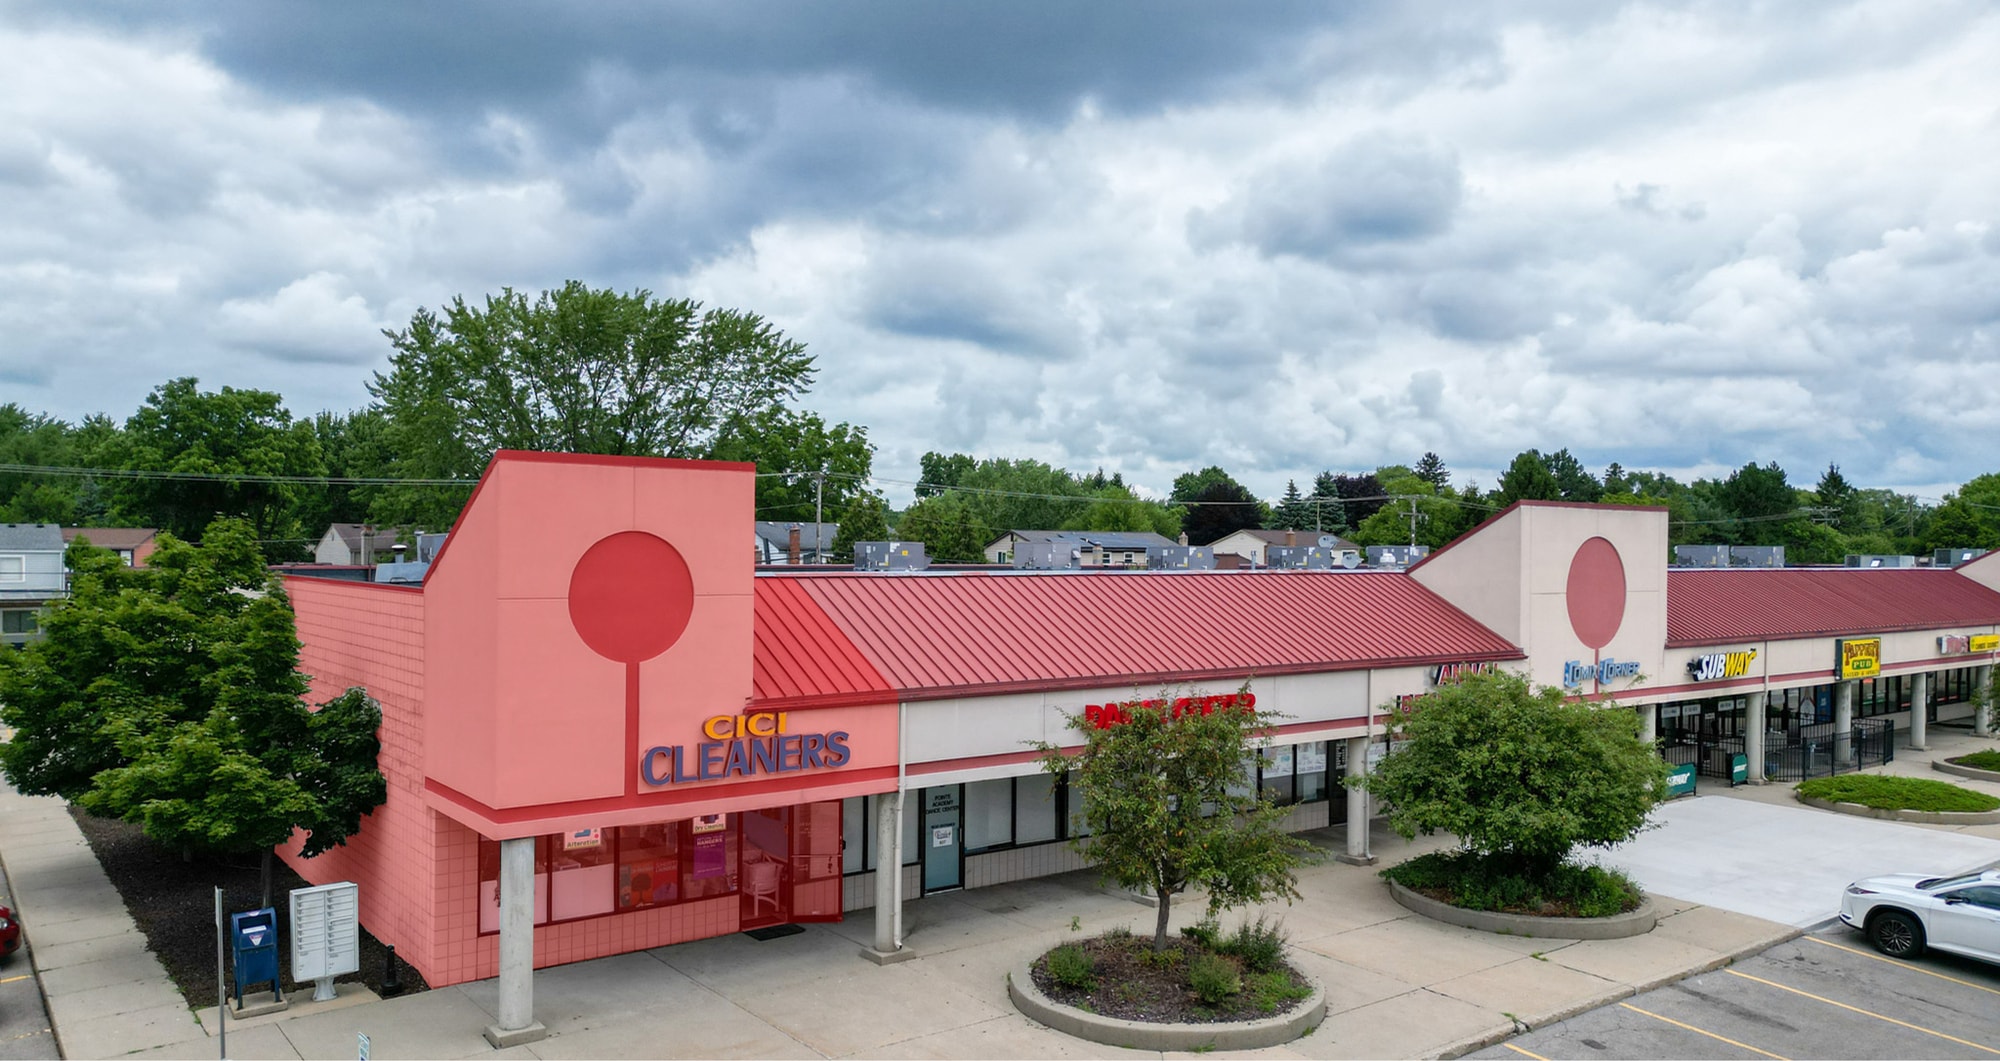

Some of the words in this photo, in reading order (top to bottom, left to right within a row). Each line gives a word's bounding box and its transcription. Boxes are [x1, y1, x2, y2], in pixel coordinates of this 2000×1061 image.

[1564, 660, 1598, 687] COMIX
[1599, 658, 1640, 684] CORNER
[1694, 649, 1757, 681] SUBWAY
[1853, 660, 1872, 669] PUB
[704, 712, 788, 740] CICI
[642, 731, 850, 787] CLEANERS
[567, 839, 599, 848] Alteration
